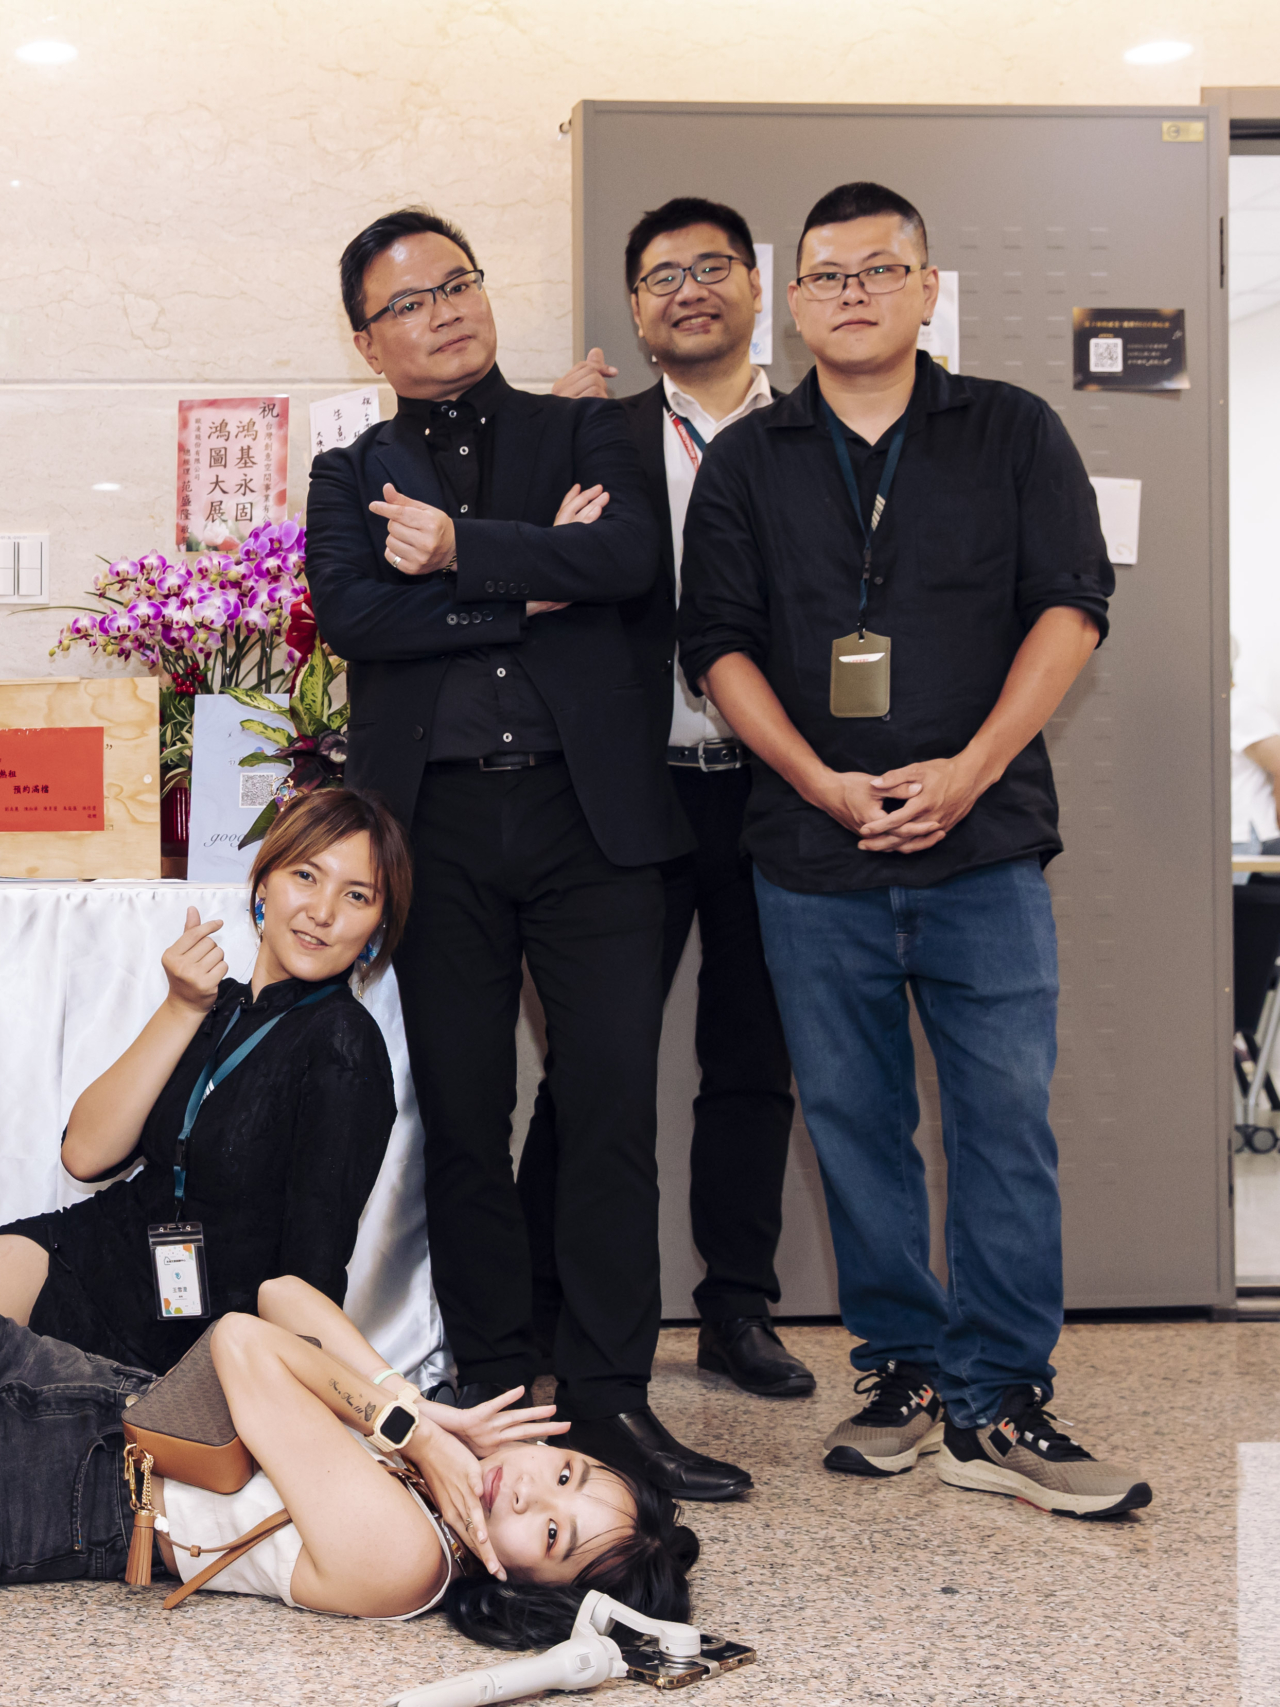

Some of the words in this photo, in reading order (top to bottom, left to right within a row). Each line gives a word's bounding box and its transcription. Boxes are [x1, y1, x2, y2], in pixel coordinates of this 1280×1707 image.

[259, 401, 280, 419] 祝
[205, 418, 230, 523] 鴻圖大展
[233, 418, 259, 522] 鴻基永固
[13, 784, 50, 795] 預約滿檔
